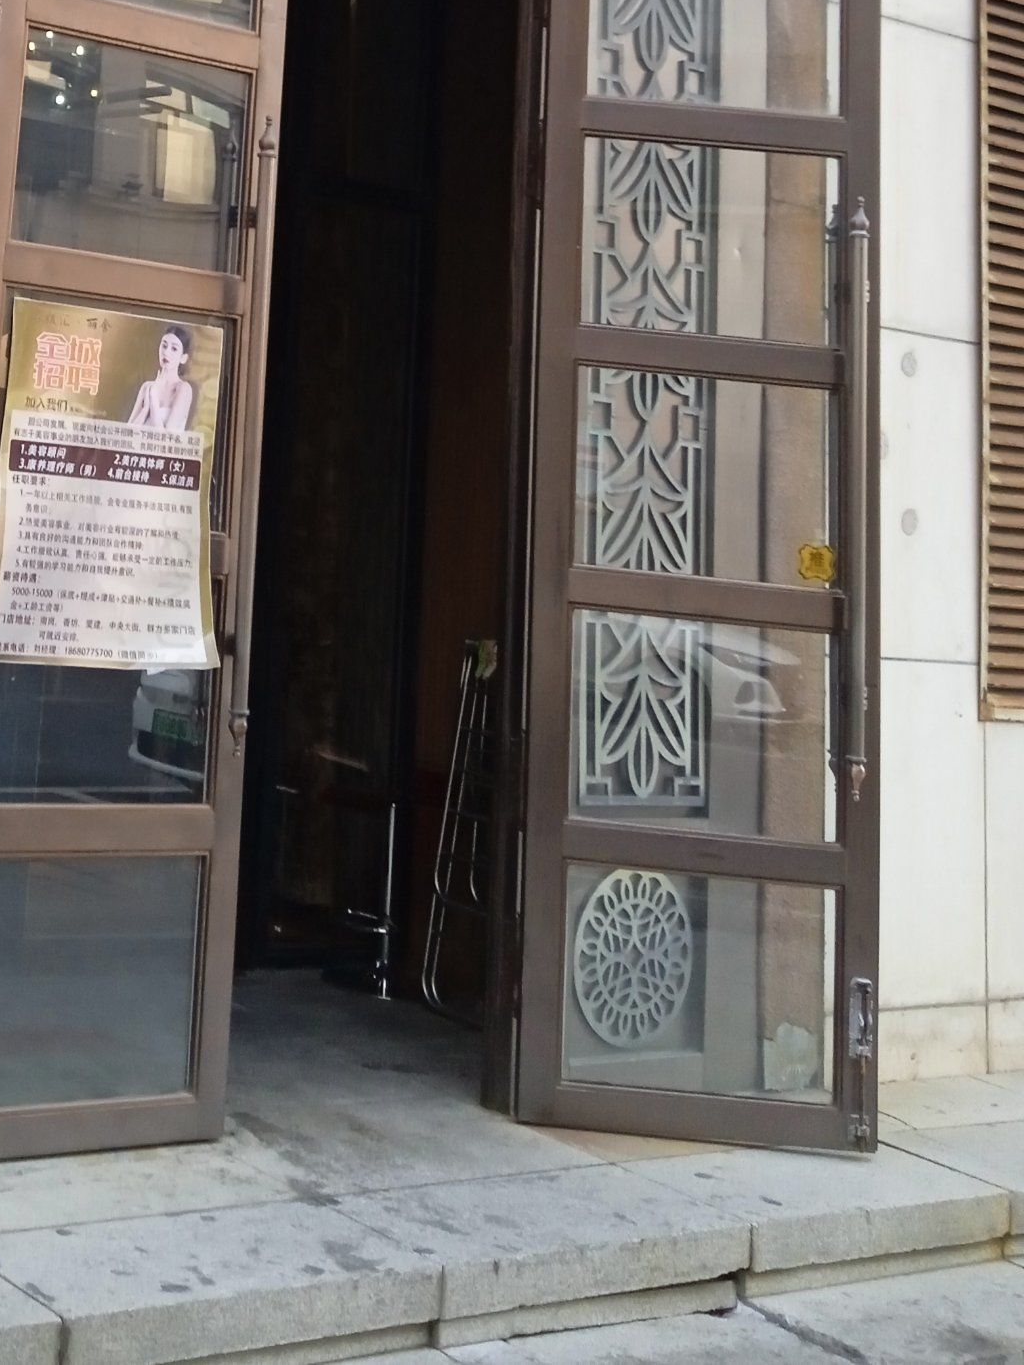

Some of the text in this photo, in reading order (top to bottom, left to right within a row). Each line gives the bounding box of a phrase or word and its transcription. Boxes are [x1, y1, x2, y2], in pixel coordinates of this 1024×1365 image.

[33, 360, 100, 395] 招聘
[25, 396, 68, 411] 加入我们
